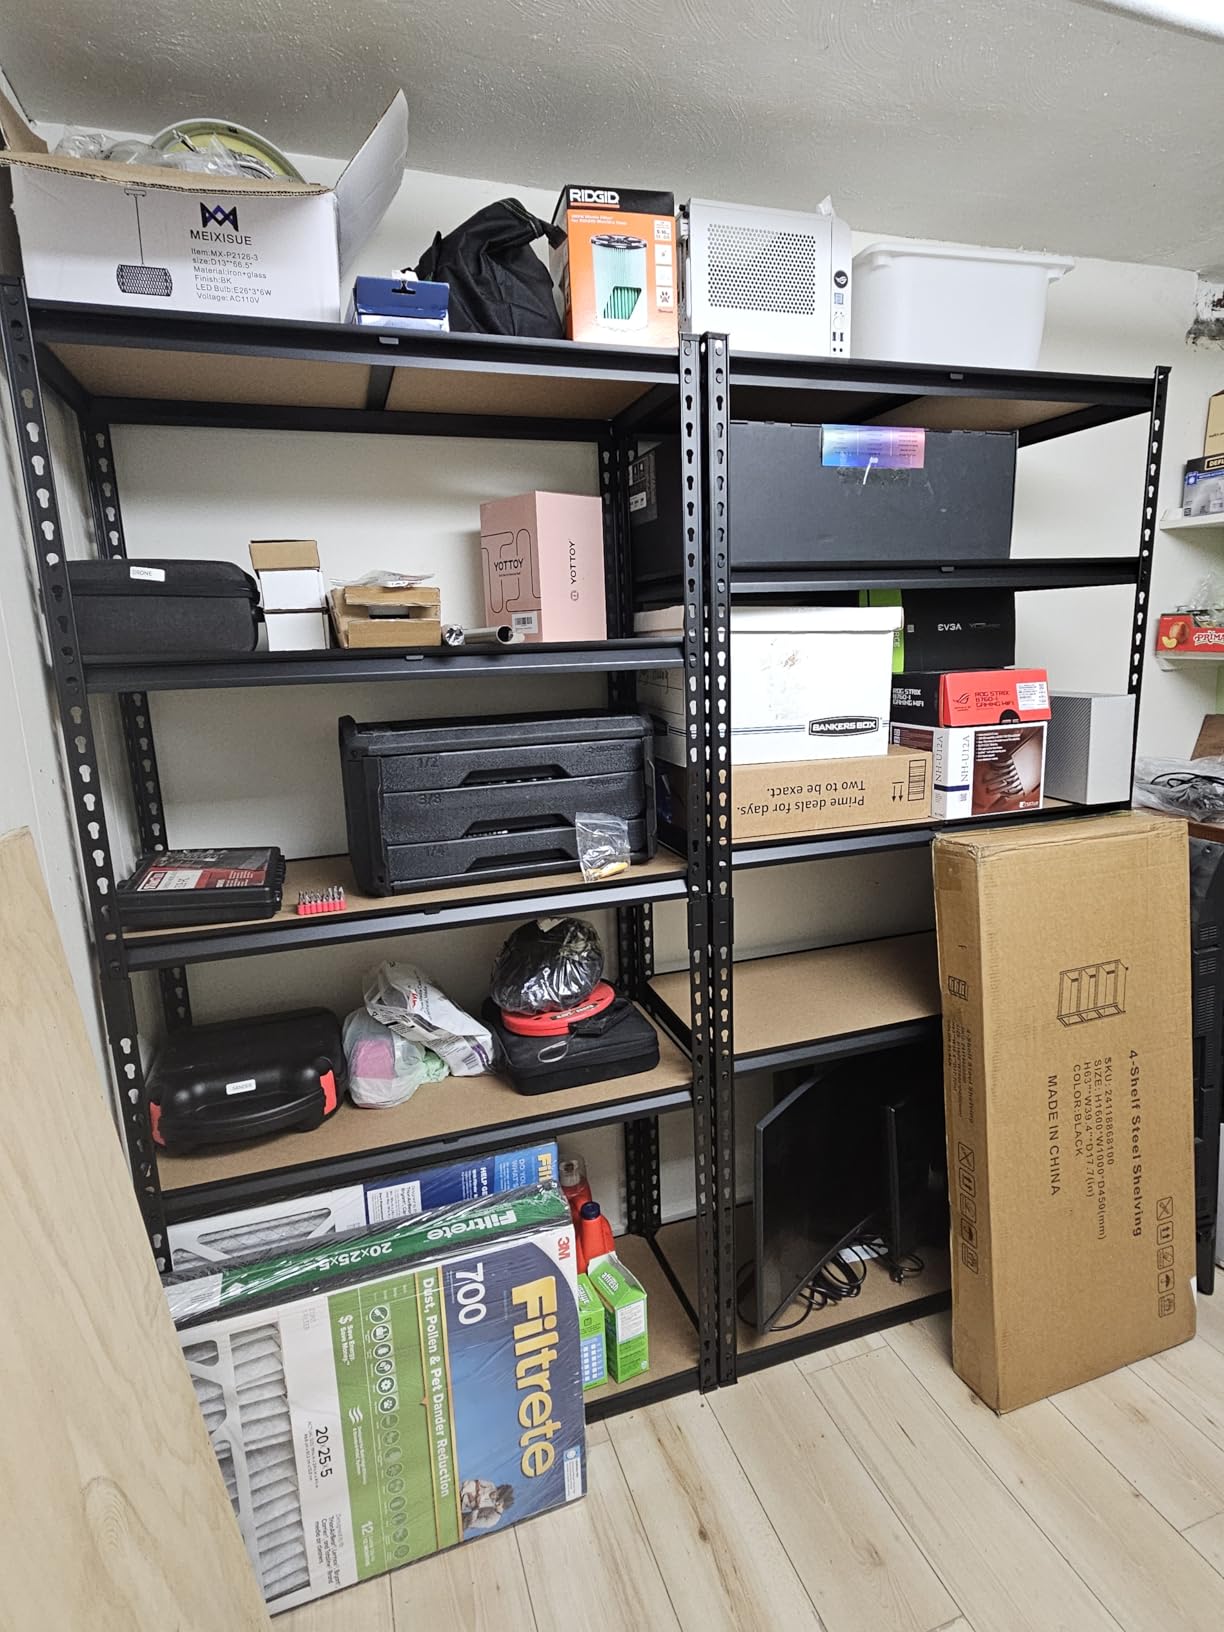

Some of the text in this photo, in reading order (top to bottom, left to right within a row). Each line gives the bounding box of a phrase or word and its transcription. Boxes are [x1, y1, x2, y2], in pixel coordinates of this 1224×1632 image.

[570, 188, 620, 204] RIDGID
[190, 229, 252, 245] MEIXISUE
[194, 275, 233, 285] Finish:BK
[195, 283, 213, 292] LED
[196, 292, 261, 304] Voltage: AC110V
[493, 557, 524, 571] YOTTOY
[568, 540, 578, 585] YOTTOY
[937, 623, 963, 631] EVGA
[812, 721, 876, 732] BANKERS BOX
[960, 735, 970, 783] NH-U12A
[767, 780, 865, 798] Two to be exact.
[736, 795, 865, 816] Prime deals for days.
[1094, 1059, 1103, 1092] SIZE:
[1103, 1056, 1112, 1085] SKU:
[1073, 1064, 1083, 1156] COLOR:BLACK
[1047, 1074, 1061, 1196] MADE IN CHINA
[1129, 1049, 1142, 1237] 4-Shelf Steel Shelving
[480, 1166, 488, 1186] HELP
[427, 1210, 517, 1239] Filtrete
[319, 1242, 392, 1271] 20x25x5
[557, 1237, 570, 1260] 3M
[455, 1262, 487, 1325] 700
[423, 1277, 449, 1497] Dust, Pollen & Pet Dander Reduction
[511, 1275, 562, 1479] Filtrete
[360, 1520, 374, 1536] 12
